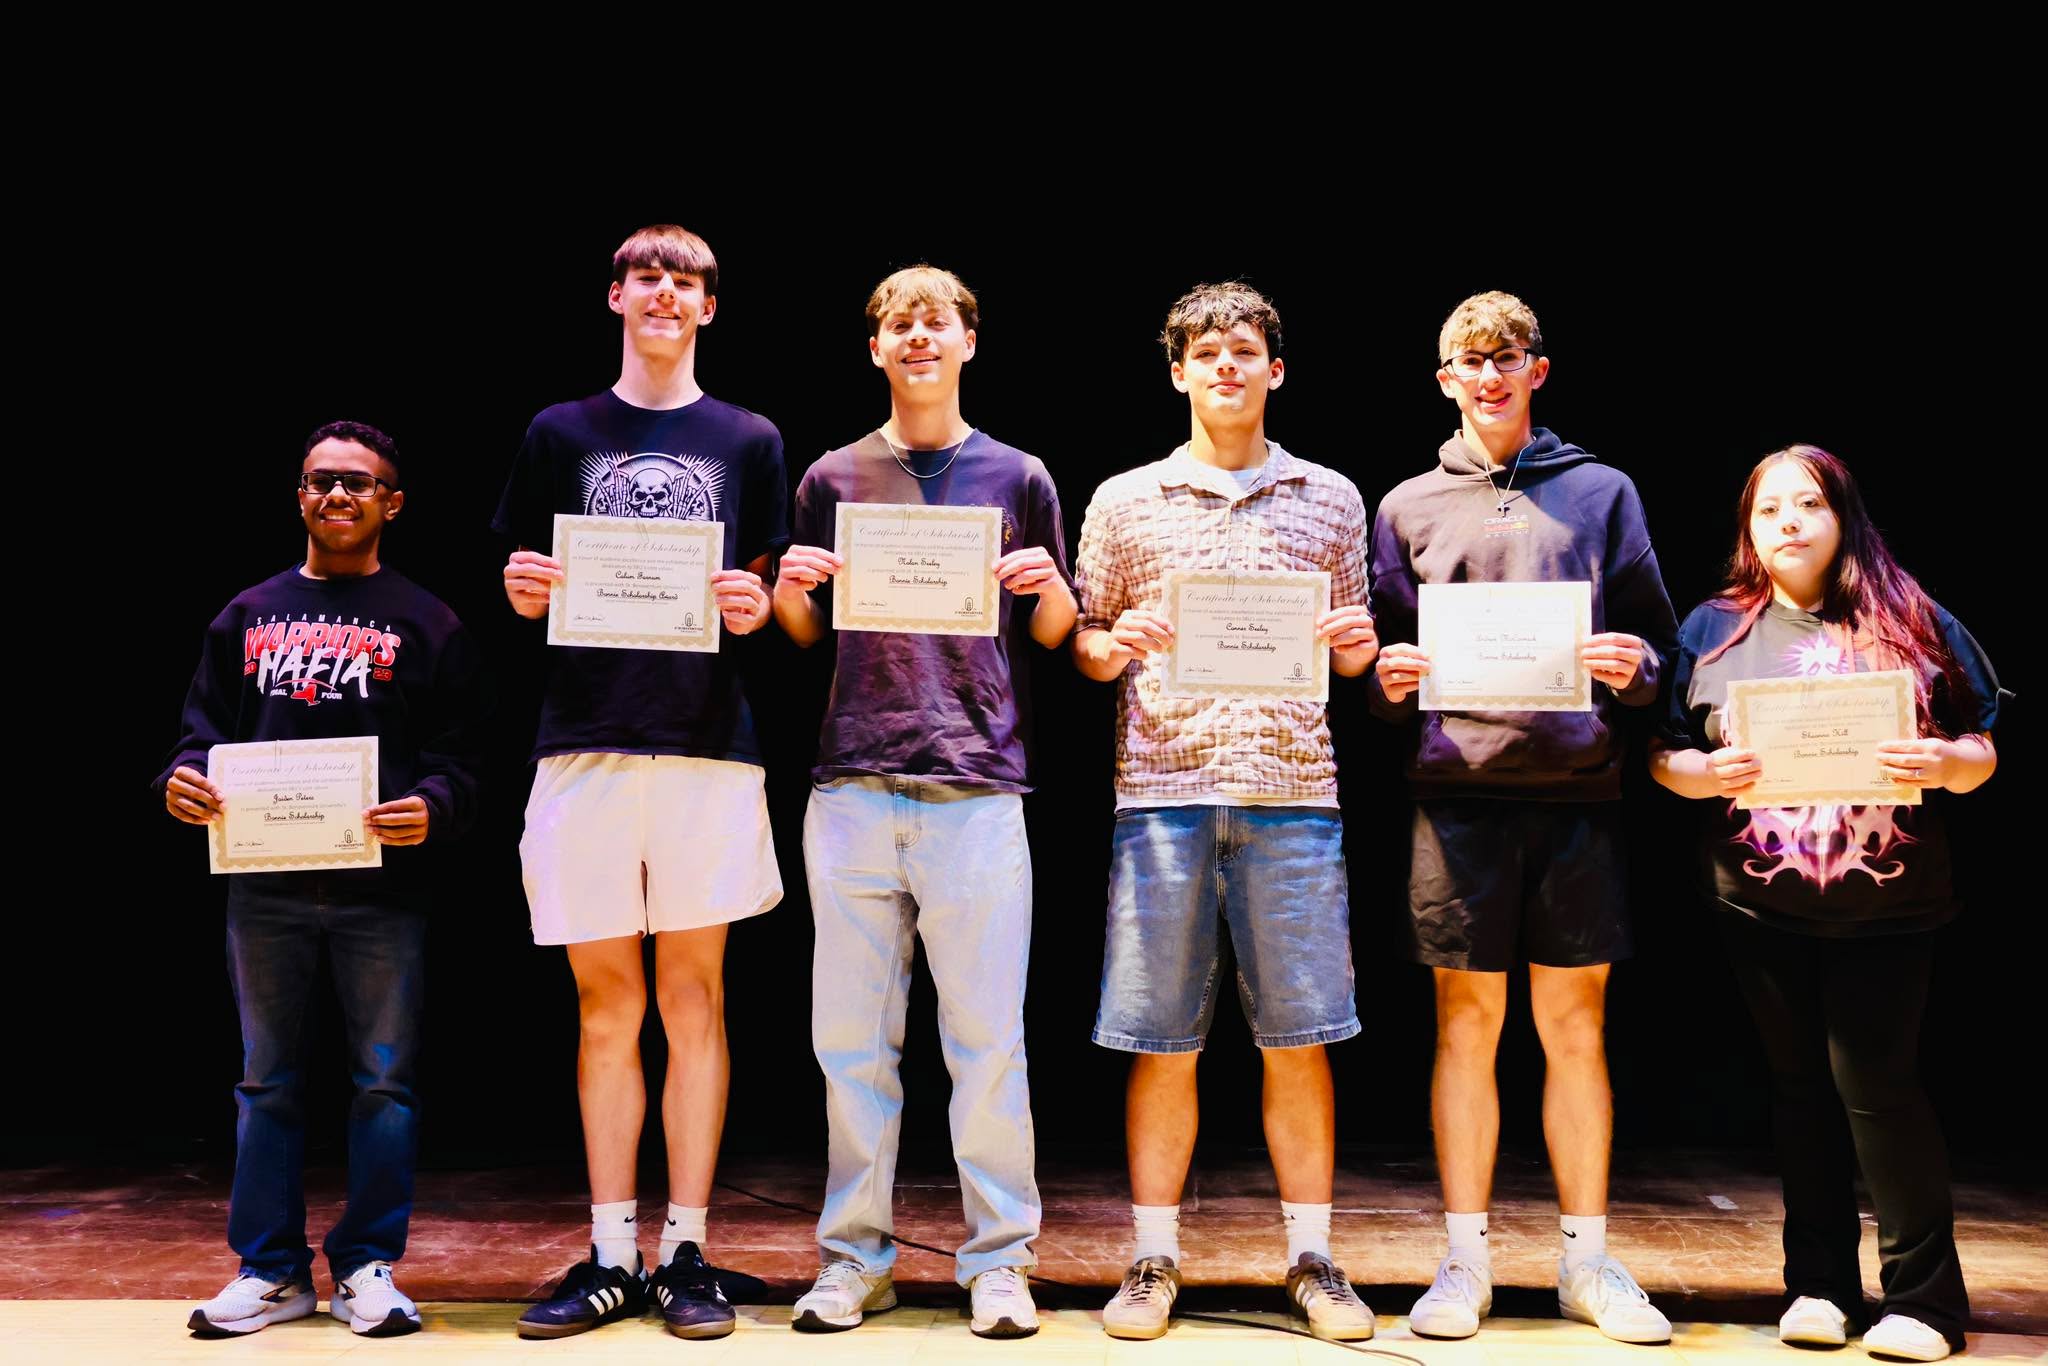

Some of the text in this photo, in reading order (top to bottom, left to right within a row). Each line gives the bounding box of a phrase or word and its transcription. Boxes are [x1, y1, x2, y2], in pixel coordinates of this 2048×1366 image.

[859, 527, 909, 538] Certificate
[923, 528, 981, 543] Scholarship
[576, 538, 627, 552] Certificate
[641, 541, 702, 557] Scholarship
[889, 575, 948, 588] Bonnie Scholarship
[621, 589, 657, 602] Scholarship
[1186, 591, 1235, 605] Certificate
[1251, 593, 1310, 608] Scholarship
[257, 613, 392, 633] SALAMANCA
[245, 621, 402, 667] WARRIORS
[1217, 640, 1277, 653] Bonnie Scholarship
[256, 643, 372, 698] MAFIA
[372, 667, 393, 682] 23
[321, 691, 343, 700] FOUR
[1820, 747, 1859, 759] Scholarship
[264, 811, 325, 822] Bonnie Scholarship
